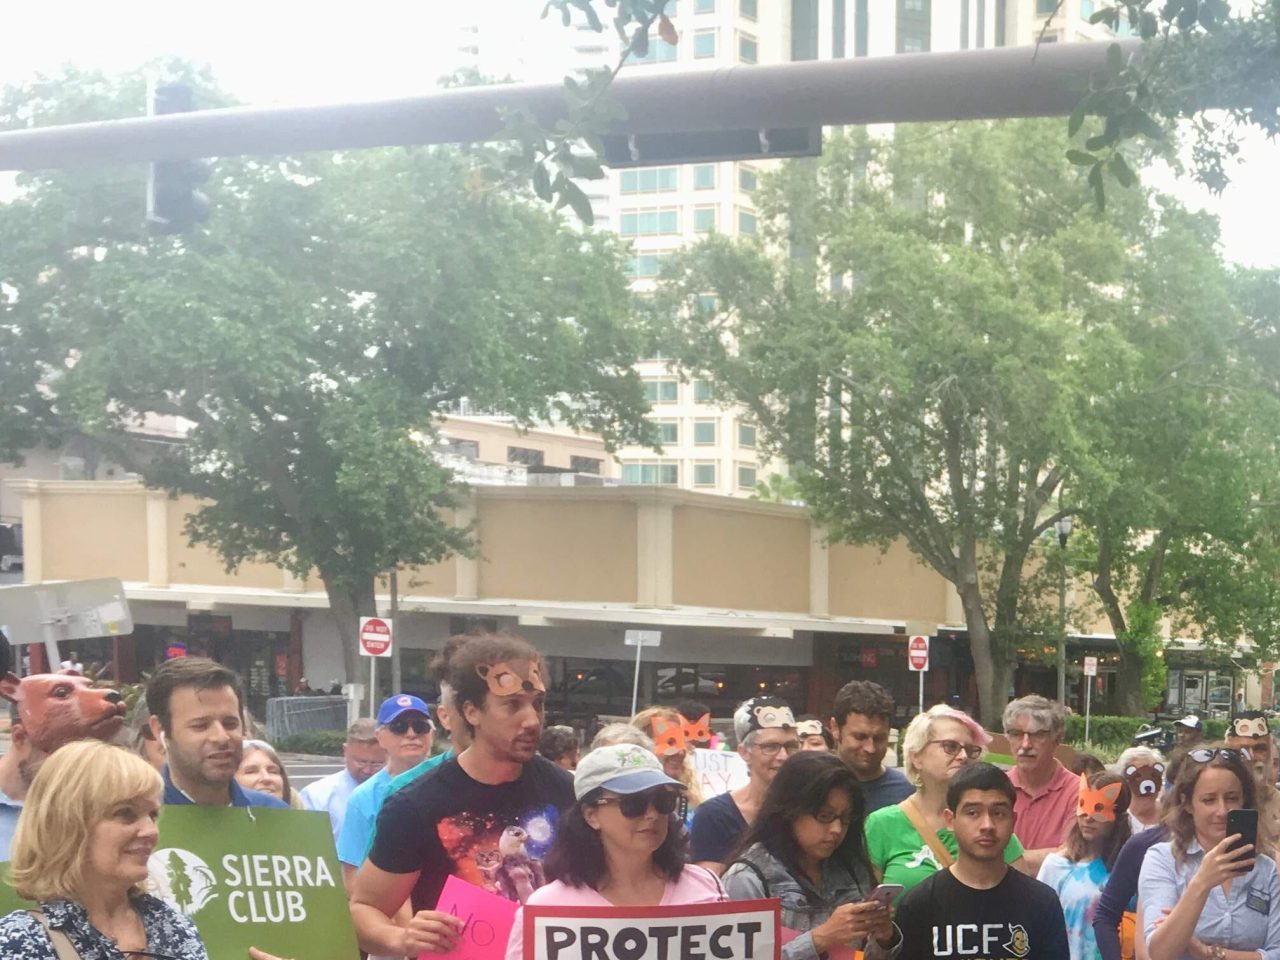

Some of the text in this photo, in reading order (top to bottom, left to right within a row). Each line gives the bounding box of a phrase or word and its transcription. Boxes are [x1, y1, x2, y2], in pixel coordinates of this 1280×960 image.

[694, 753, 734, 773] UST
[221, 854, 336, 888] SIERRA
[228, 890, 307, 924] CLUB
[932, 923, 1004, 956] UCF
